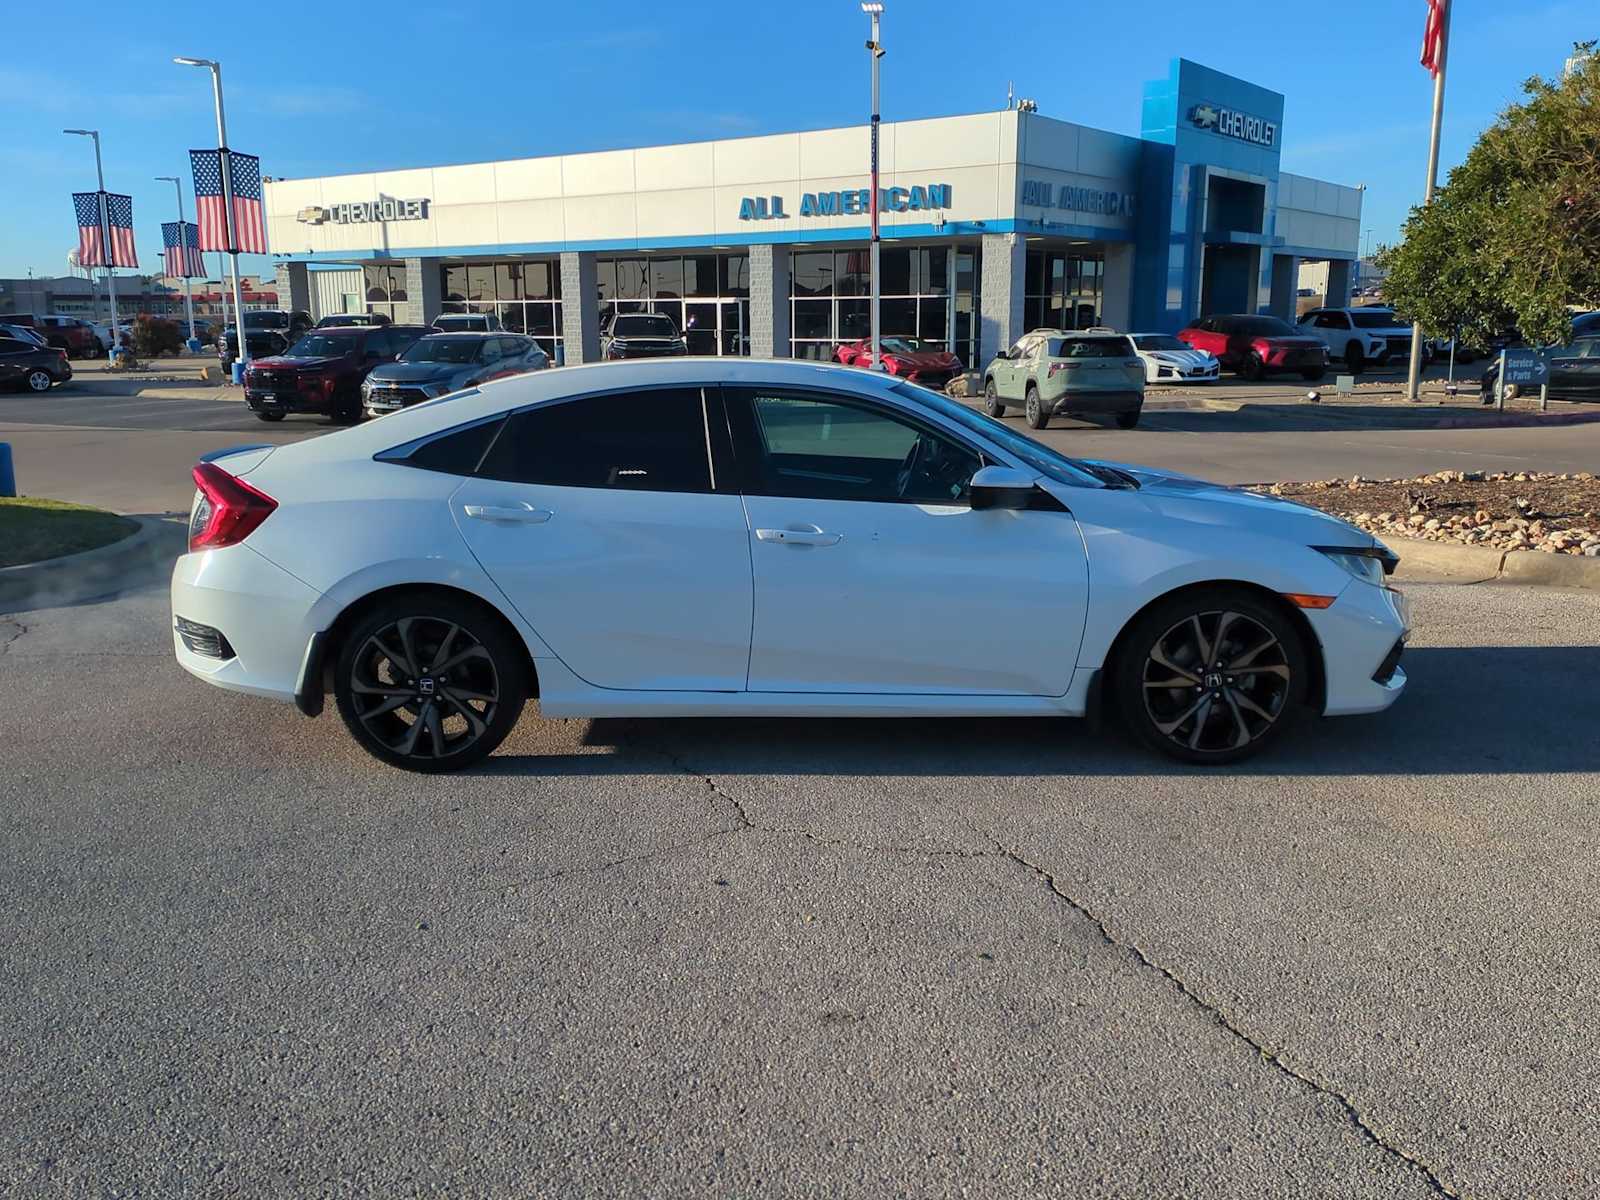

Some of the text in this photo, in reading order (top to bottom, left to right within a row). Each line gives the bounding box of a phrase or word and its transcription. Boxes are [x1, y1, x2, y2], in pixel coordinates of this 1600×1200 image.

[1219, 109, 1276, 146] CHEVROLET
[739, 184, 952, 220] ALL AMERCAN
[1022, 180, 1056, 207] ALL
[329, 199, 428, 224] CHEVROLET
[1508, 358, 1534, 368] Service
